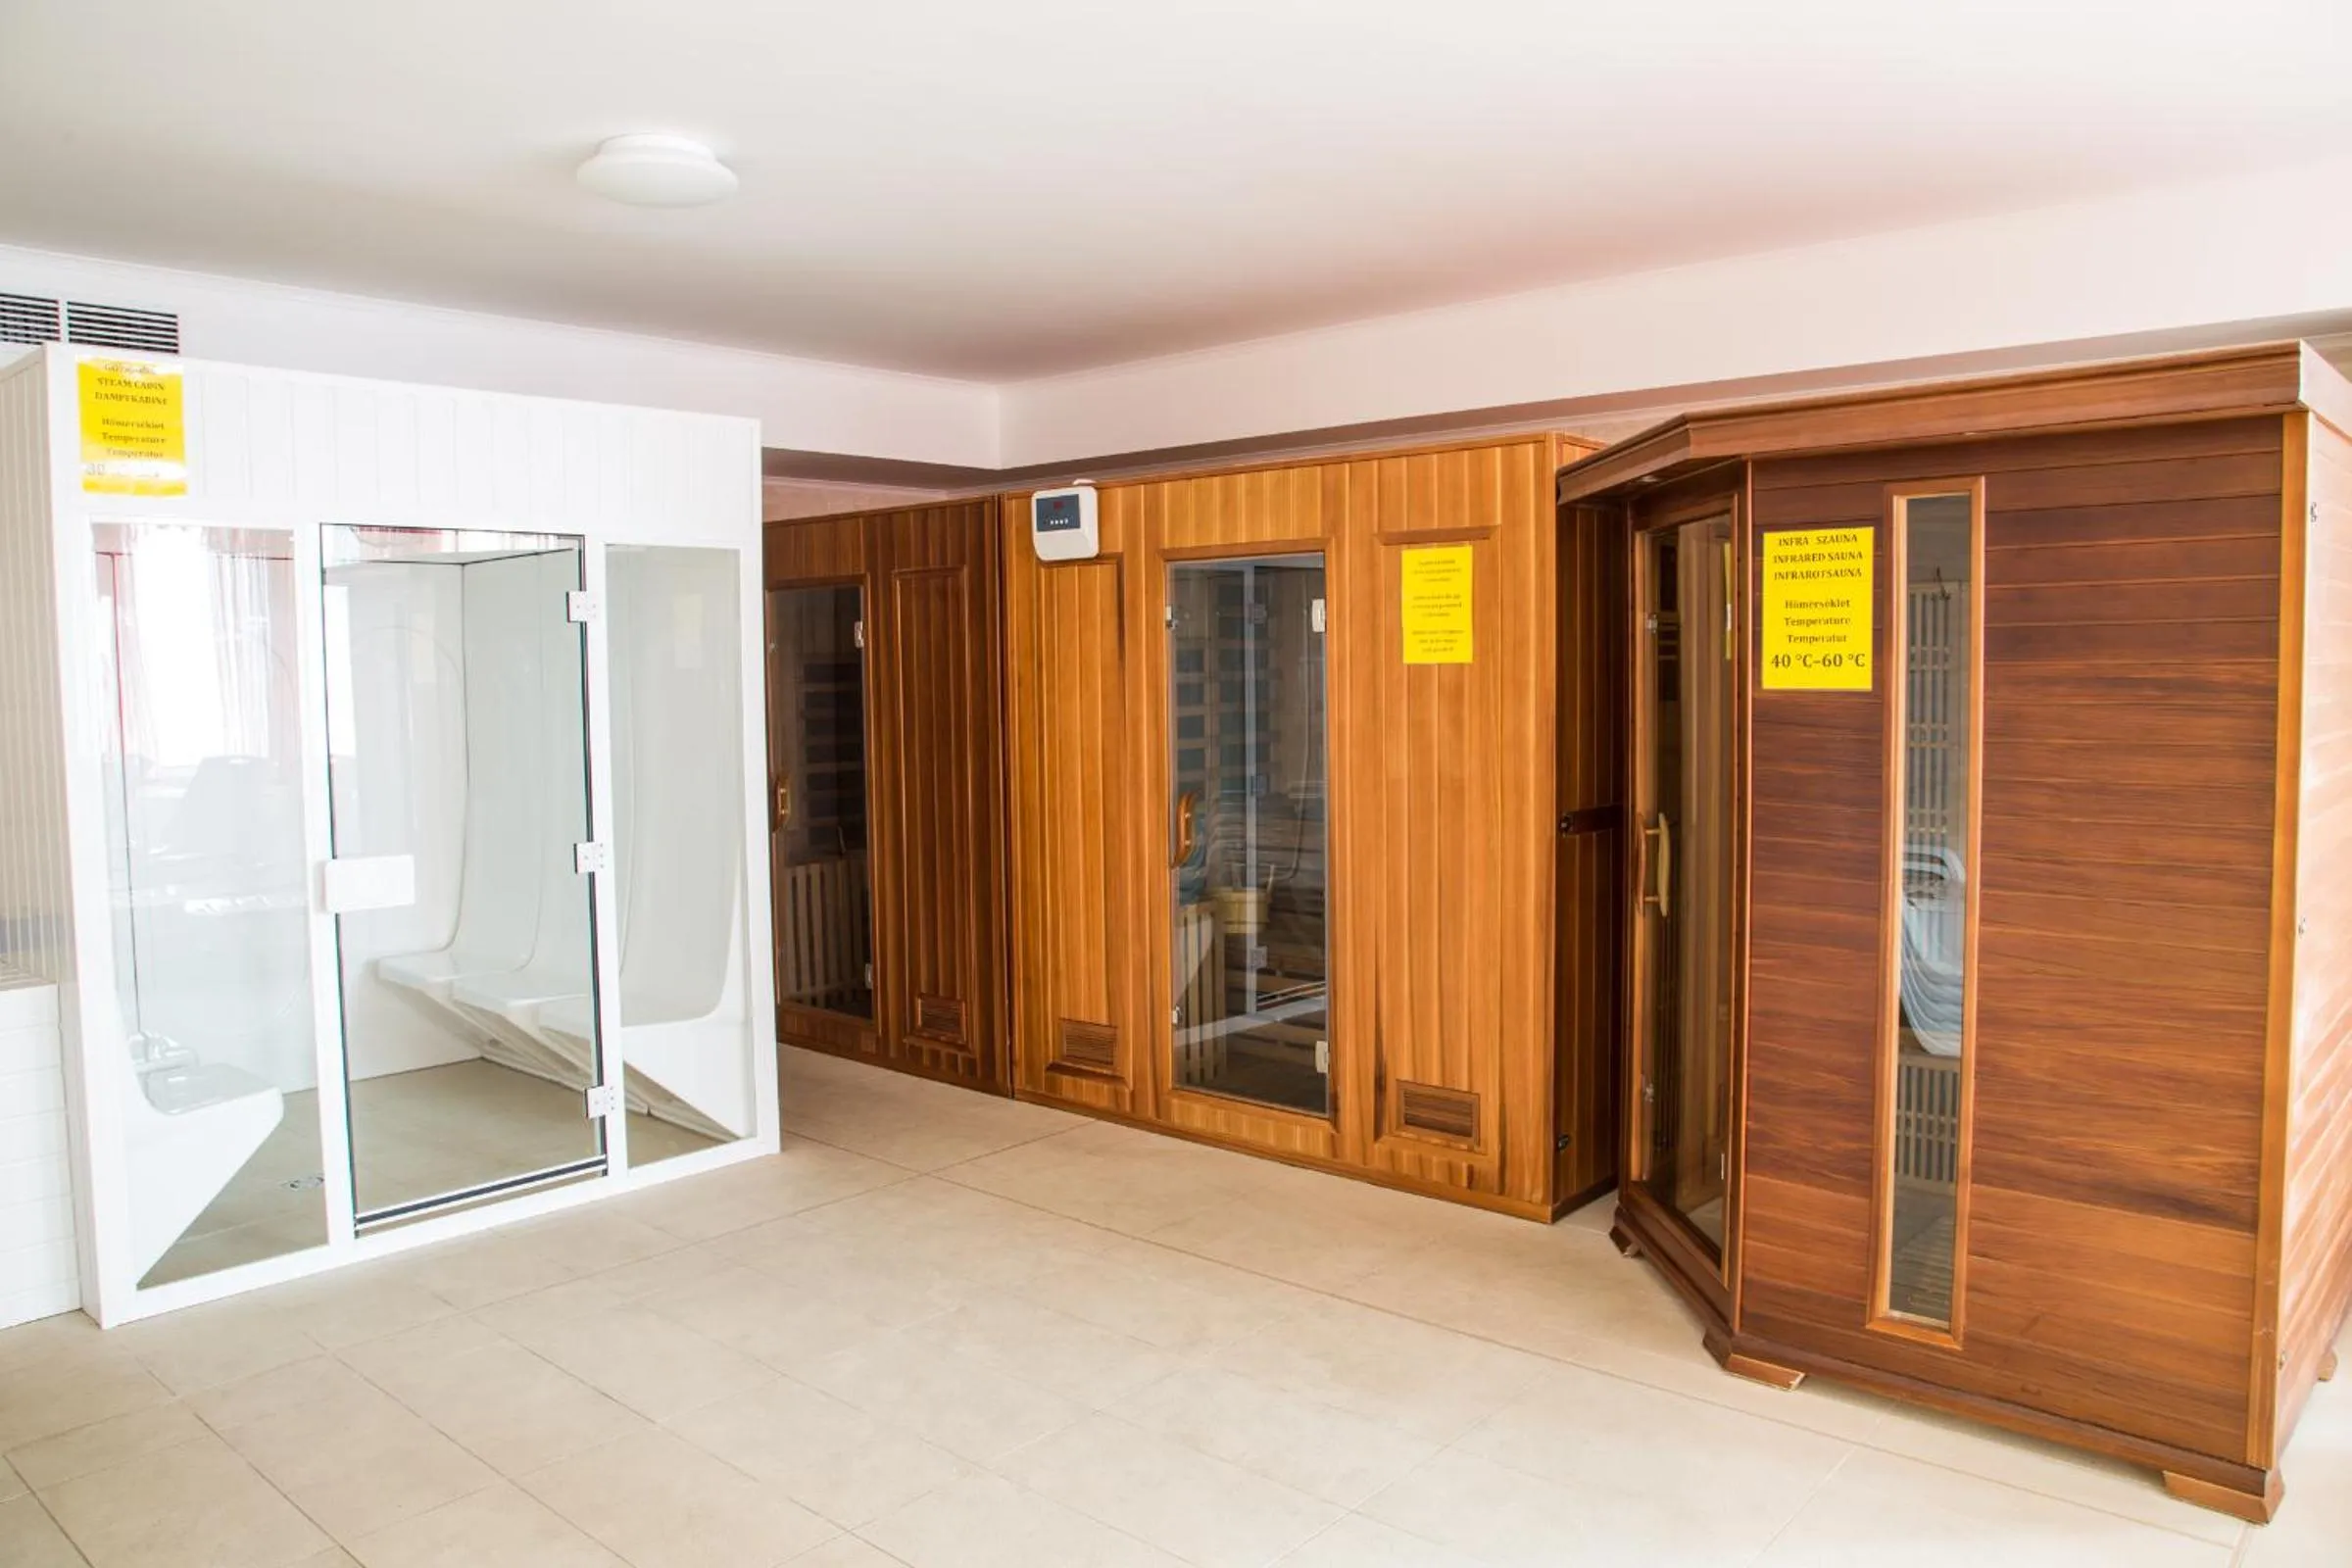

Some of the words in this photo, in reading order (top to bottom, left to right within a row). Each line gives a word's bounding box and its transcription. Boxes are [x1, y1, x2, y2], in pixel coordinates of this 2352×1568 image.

[97, 376, 132, 388] STEAM
[1779, 536, 1809, 547] INFRA
[1816, 533, 1857, 545] SZAUNA
[1774, 552, 1826, 564] INFRARED
[1827, 550, 1863, 562] SAUNA
[1774, 567, 1862, 580] INFRAROTSAUNA
[1784, 615, 1851, 628] Temperature
[1787, 633, 1847, 645] Temperatur
[1771, 654, 1791, 668] 40
